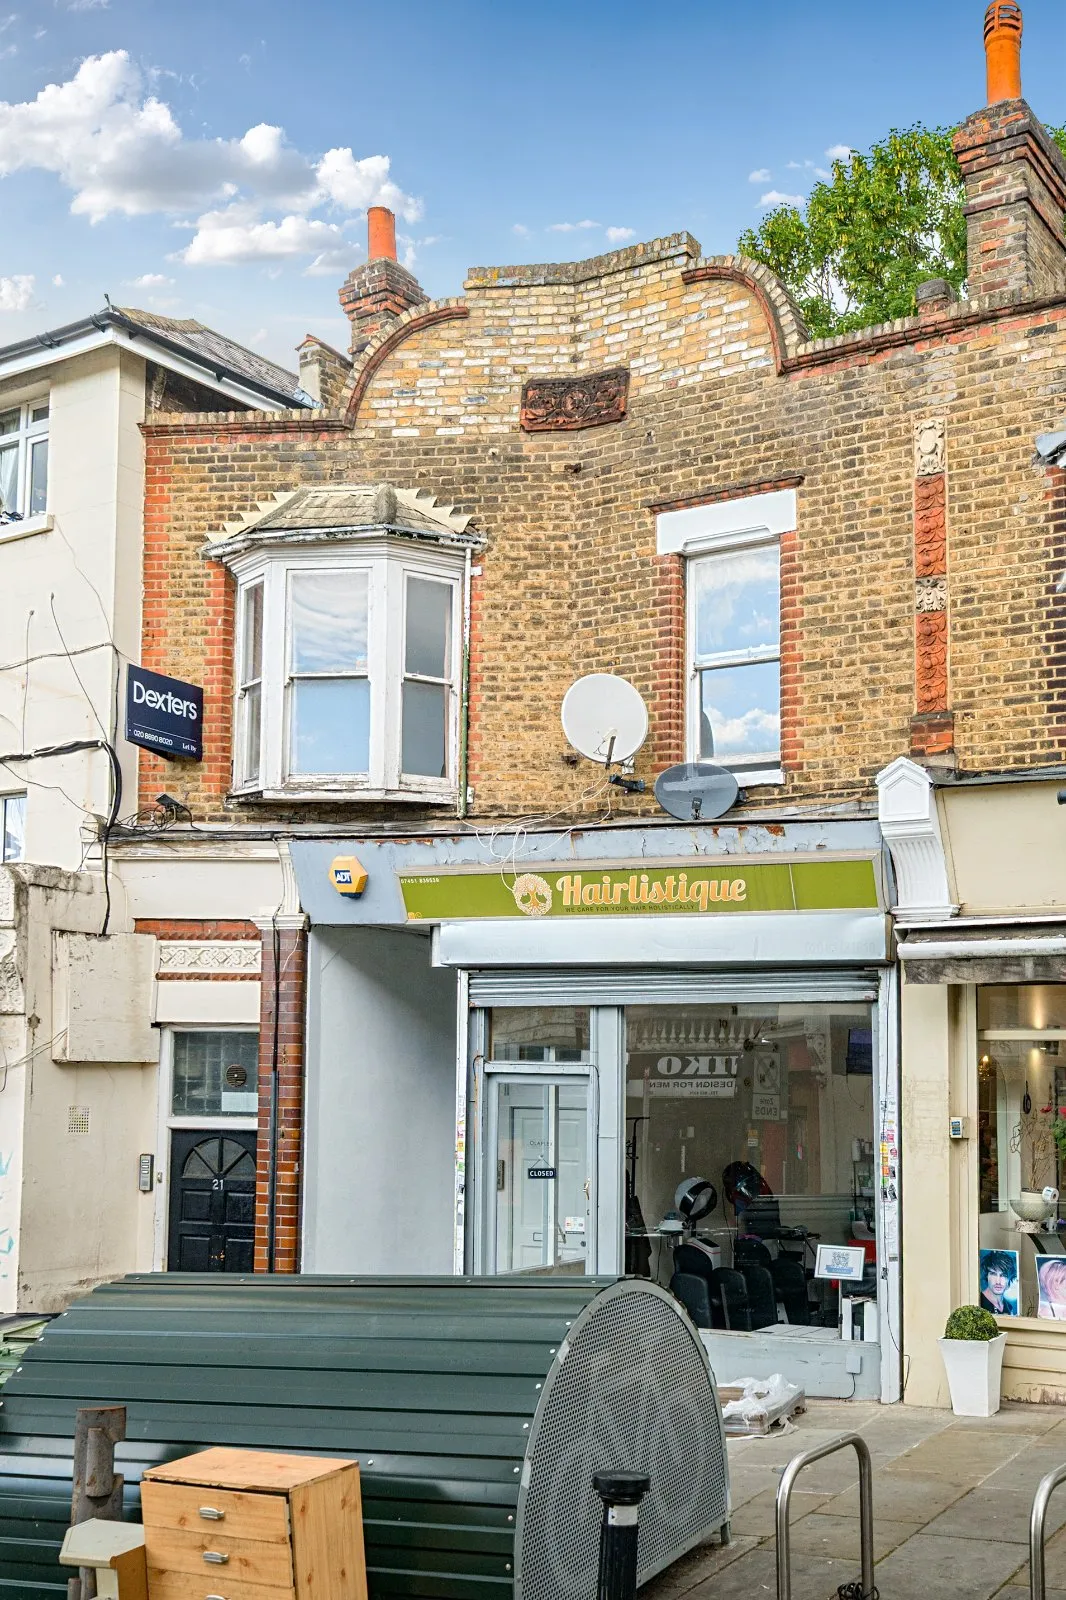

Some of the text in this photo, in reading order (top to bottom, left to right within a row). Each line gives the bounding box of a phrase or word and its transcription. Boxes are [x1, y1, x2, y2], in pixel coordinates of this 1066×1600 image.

[133, 680, 197, 719] Dexters
[133, 729, 144, 738] 020
[336, 871, 351, 882] ADT
[556, 873, 747, 911] Hairlistique
[212, 1179, 224, 1190] 21
